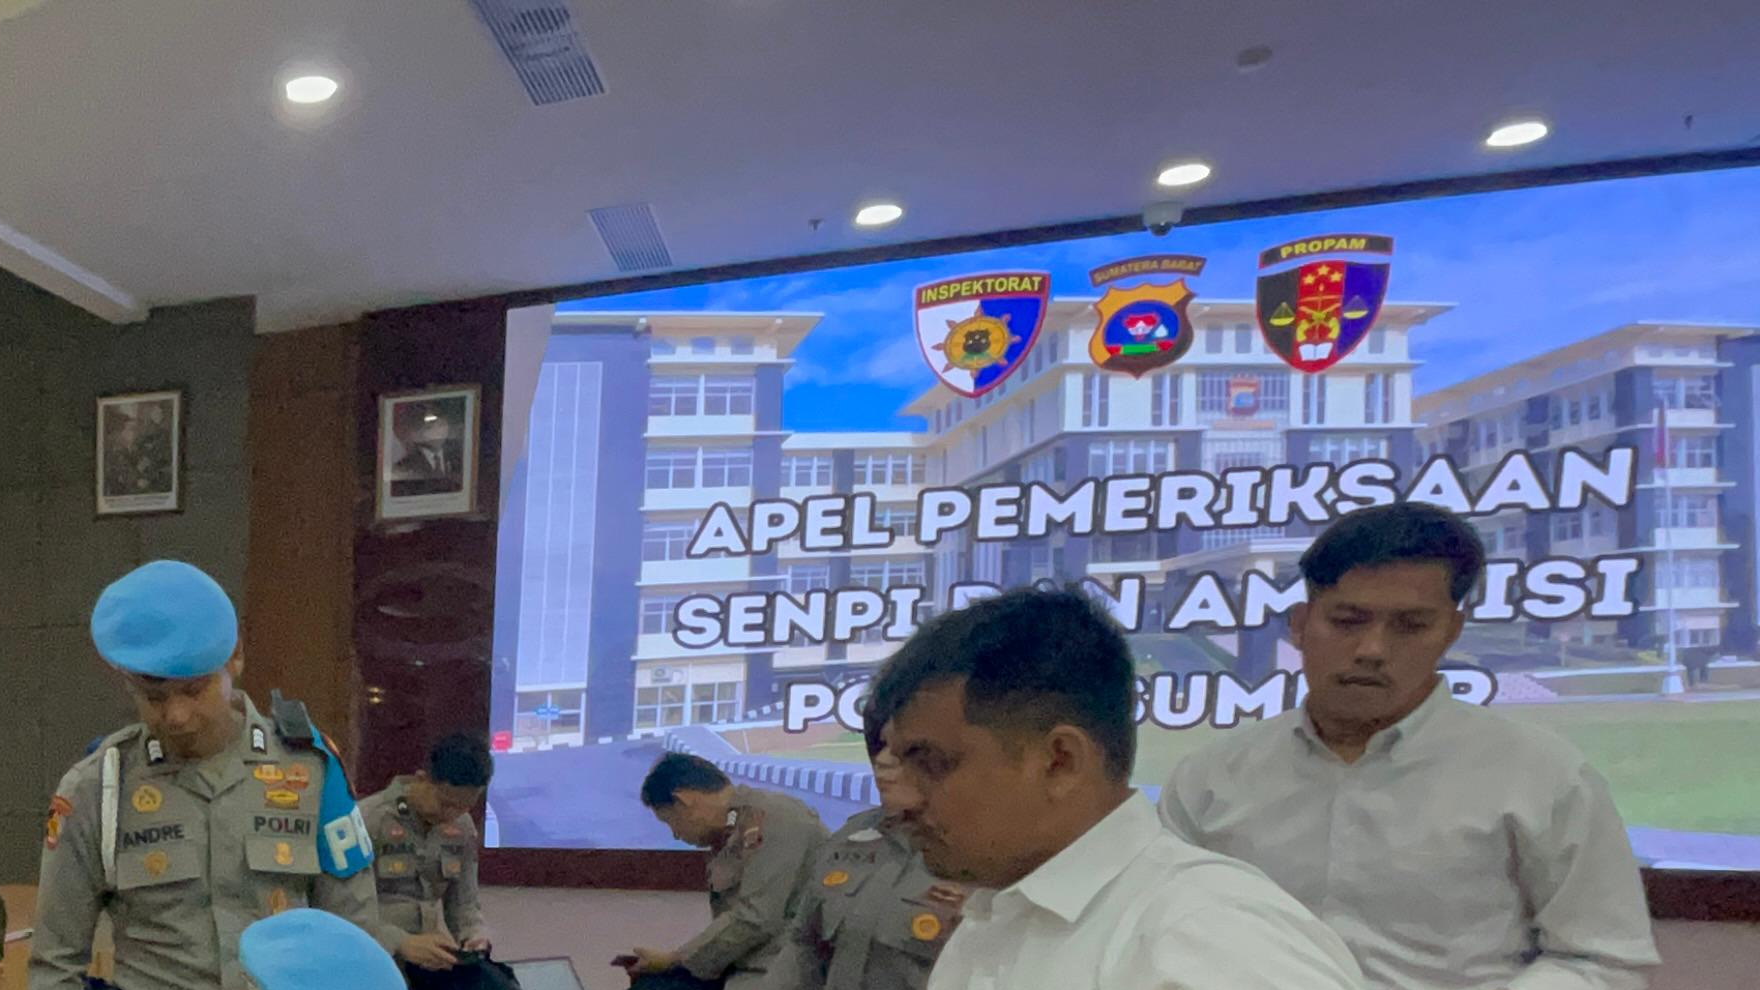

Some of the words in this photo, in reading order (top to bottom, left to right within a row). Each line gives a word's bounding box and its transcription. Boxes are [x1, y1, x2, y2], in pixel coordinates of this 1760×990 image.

[1280, 237, 1368, 258] PROPAM
[1093, 259, 1159, 283] SUMATERA
[920, 275, 1042, 304] INSPEKTORAT
[688, 493, 893, 558] APEL
[917, 446, 1637, 545] PEMERIKSAAN
[674, 585, 926, 648] SENPI
[1167, 555, 1640, 632] AMISI
[122, 823, 186, 849] ANDRE
[253, 815, 312, 835] POLRI
